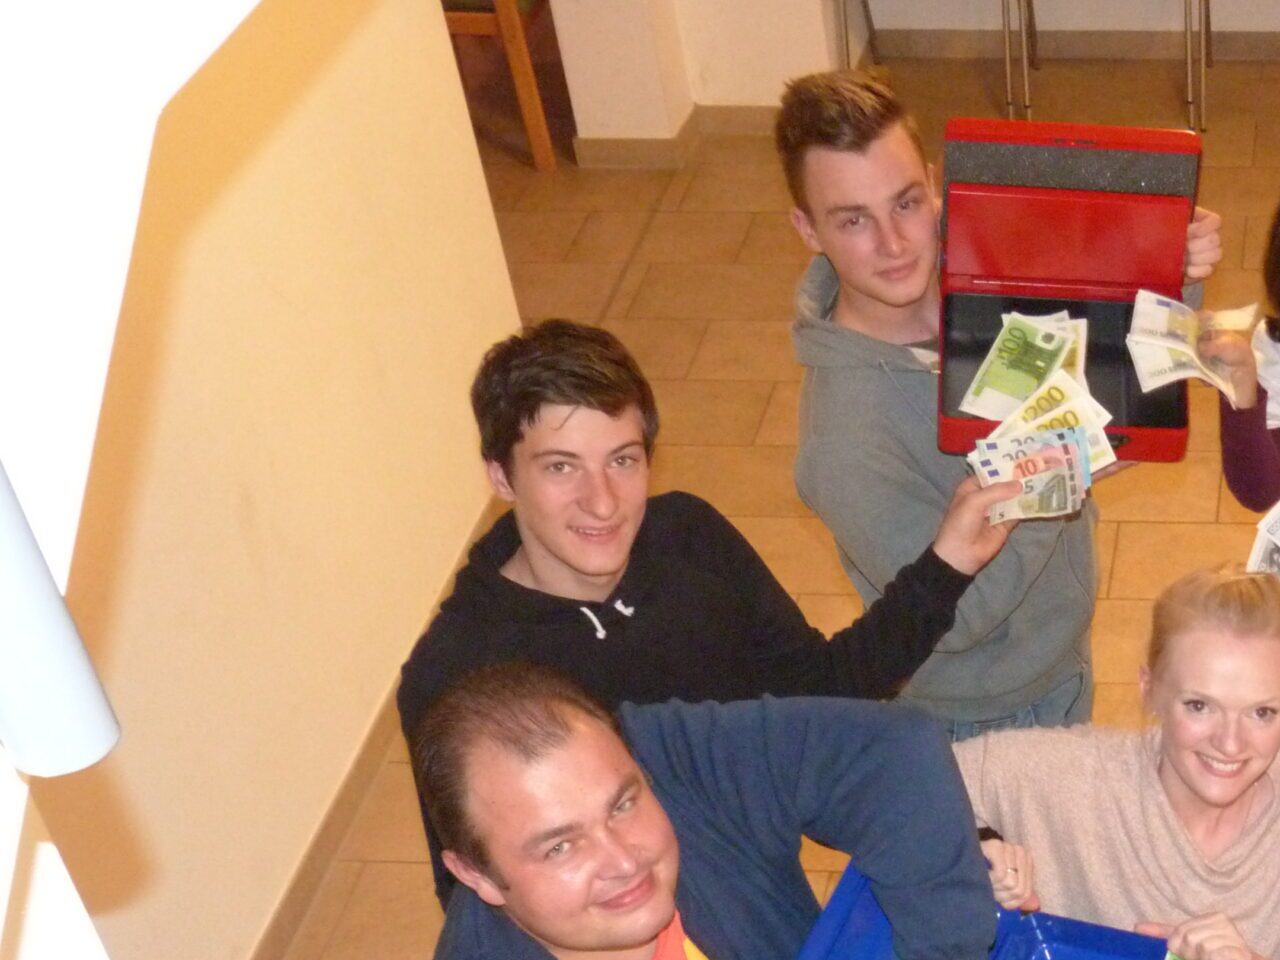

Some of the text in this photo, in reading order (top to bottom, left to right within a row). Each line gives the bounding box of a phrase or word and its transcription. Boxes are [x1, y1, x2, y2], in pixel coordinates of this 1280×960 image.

[998, 327, 1028, 357] 100
[1022, 386, 1064, 422] 200
[1015, 459, 1037, 477] 10
[1024, 480, 1034, 494] 5
